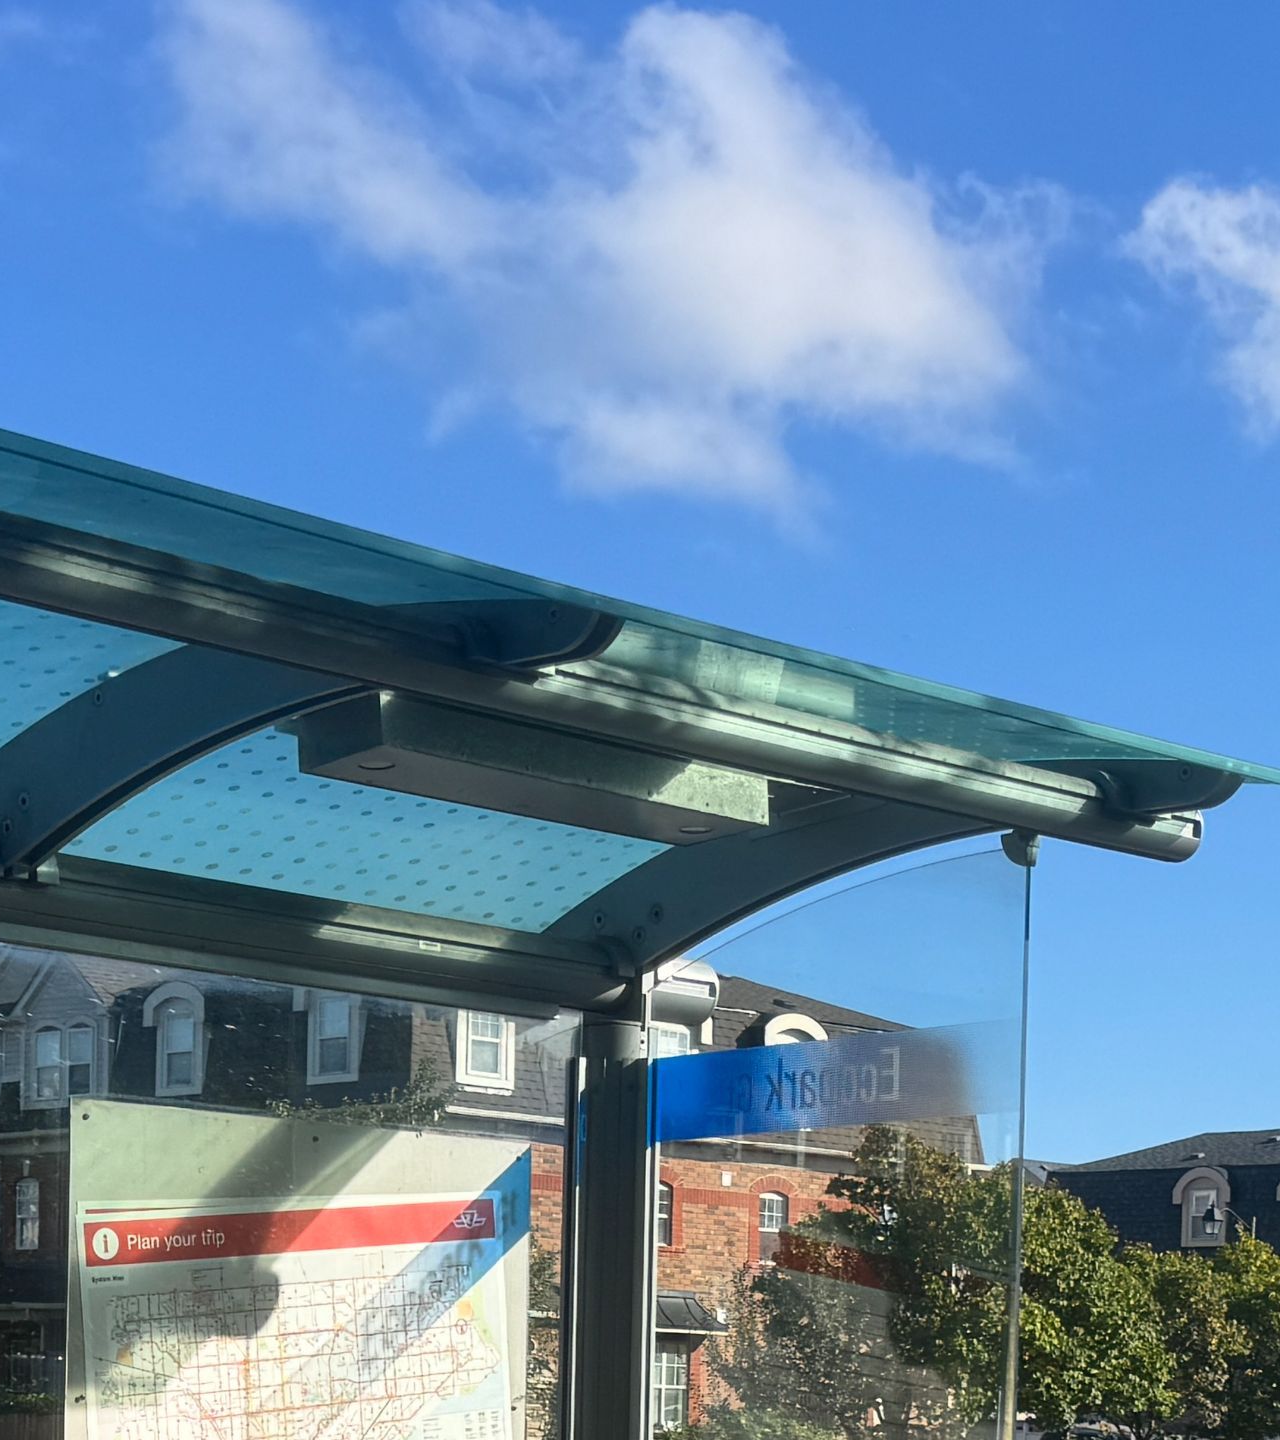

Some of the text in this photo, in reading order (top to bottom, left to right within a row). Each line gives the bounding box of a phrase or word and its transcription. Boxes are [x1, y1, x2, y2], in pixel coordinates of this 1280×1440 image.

[127, 1230, 225, 1252] Plan your trip
